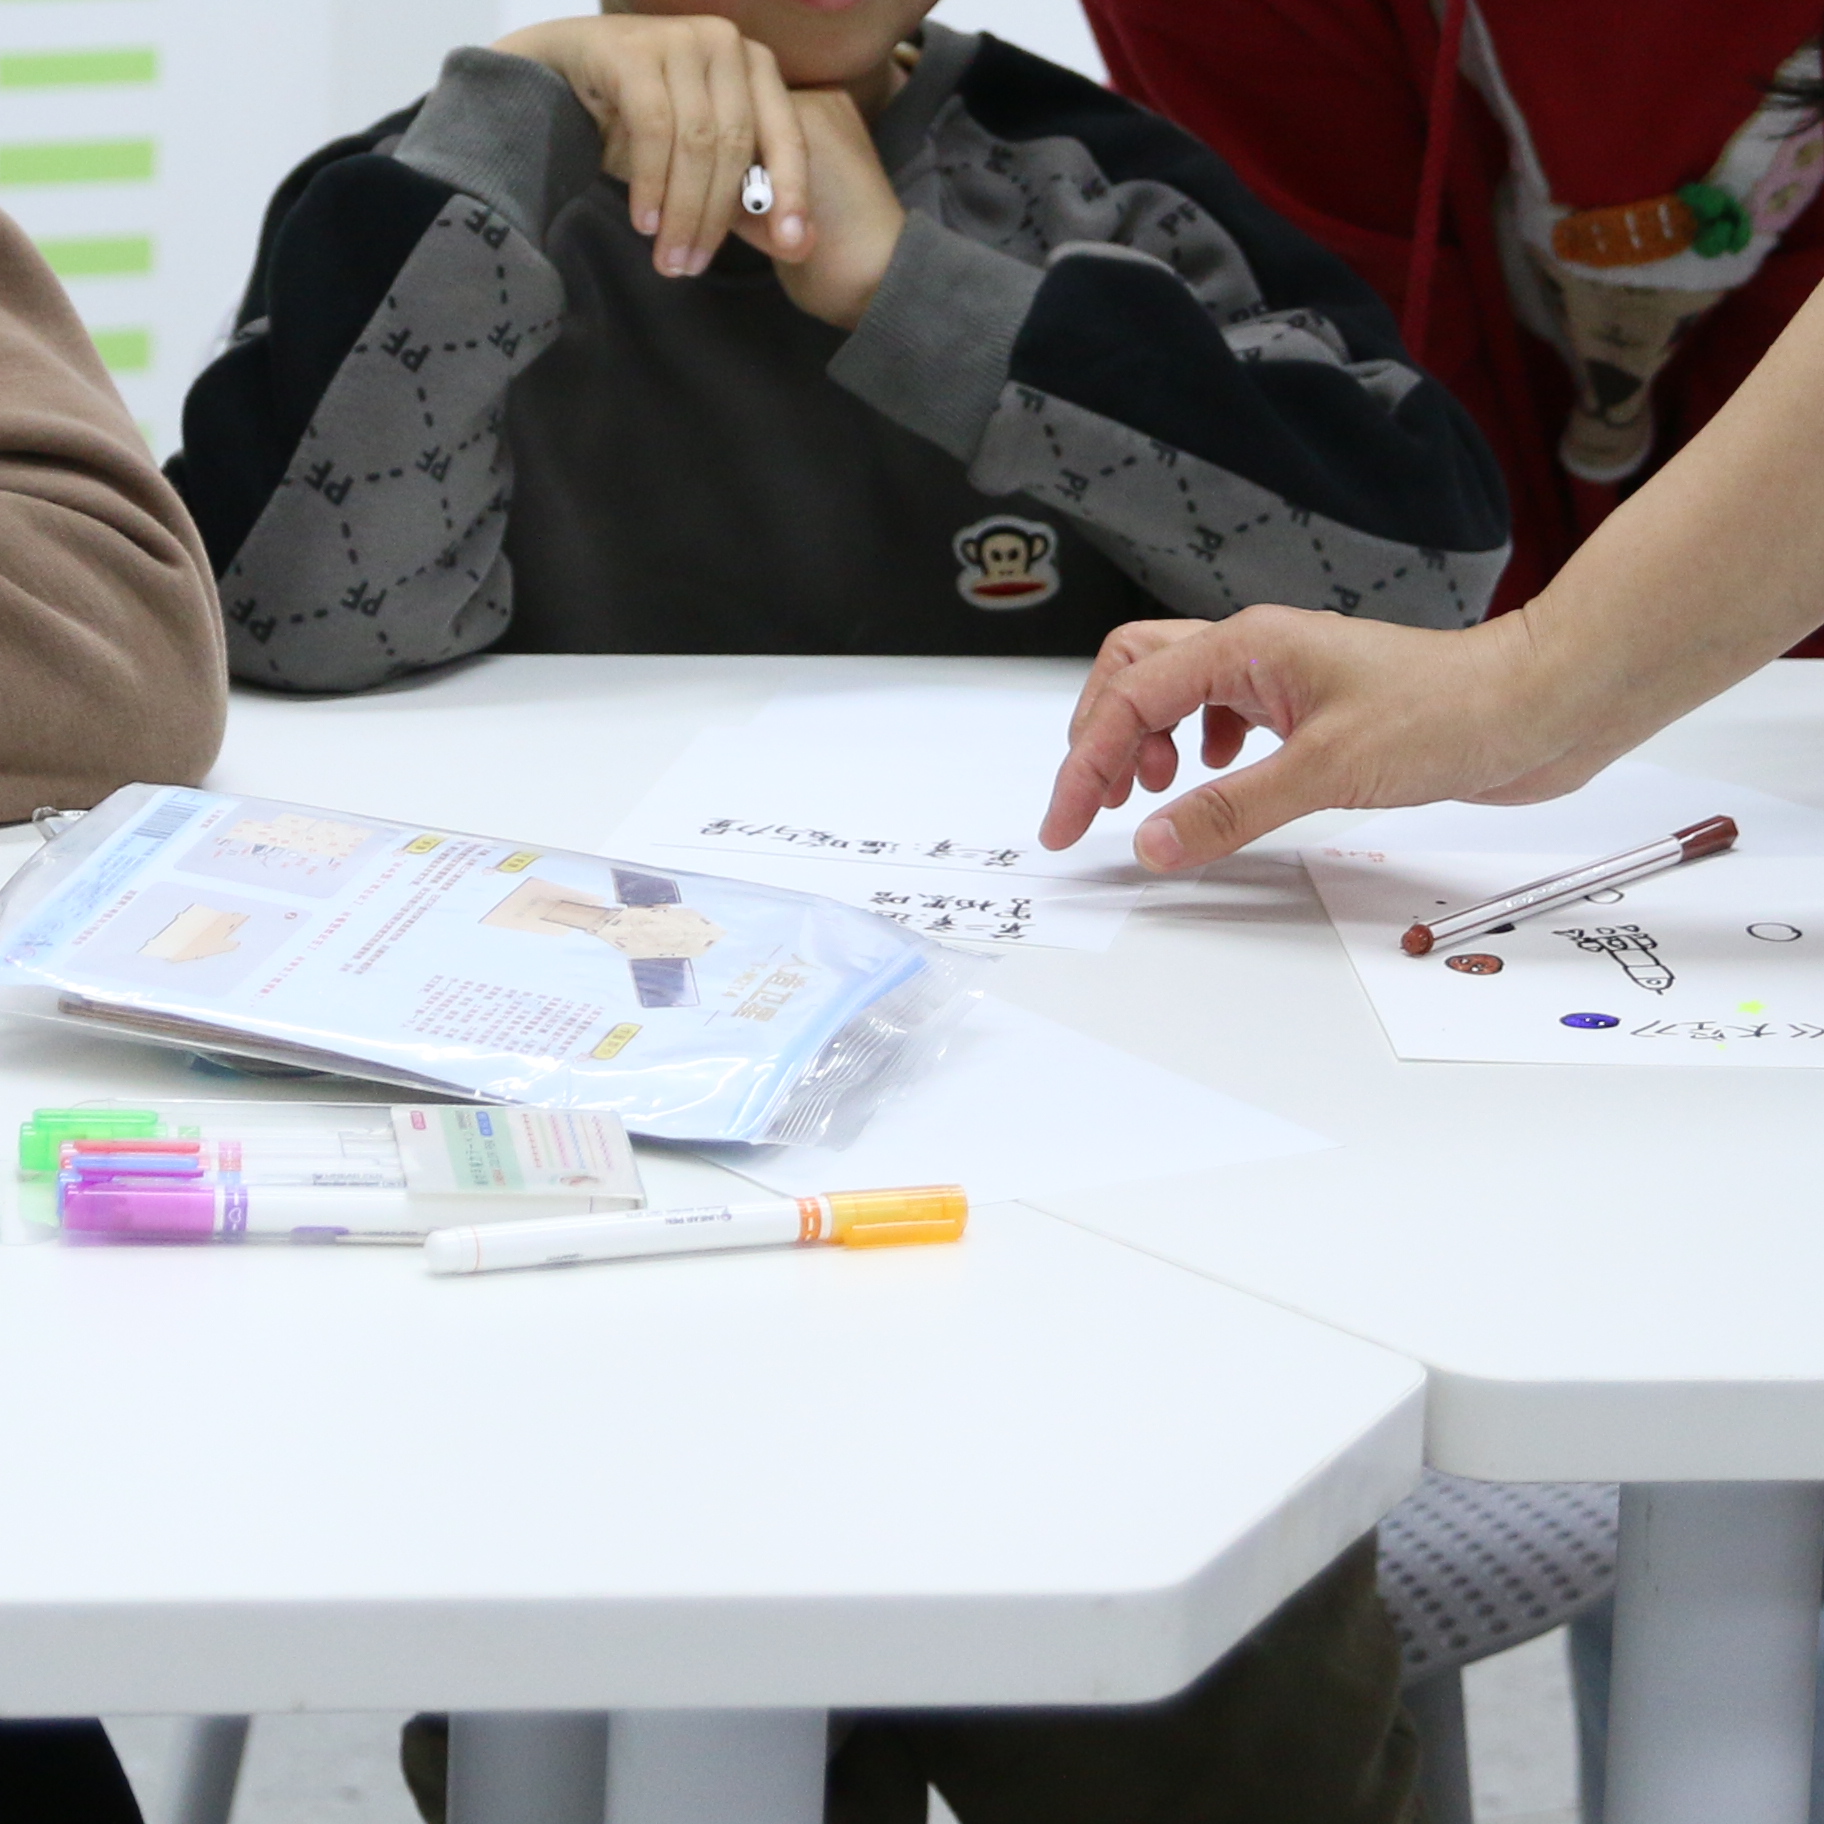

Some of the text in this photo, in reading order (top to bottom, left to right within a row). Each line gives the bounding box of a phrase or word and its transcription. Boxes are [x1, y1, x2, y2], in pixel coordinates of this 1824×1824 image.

[465, 209, 510, 250] PF
[381, 327, 430, 373] PF
[486, 321, 523, 359] PF
[304, 458, 356, 507] PF
[415, 445, 453, 483] PF
[1188, 524, 1224, 563] PF
[339, 579, 388, 618] PF
[227, 596, 277, 646] PF
